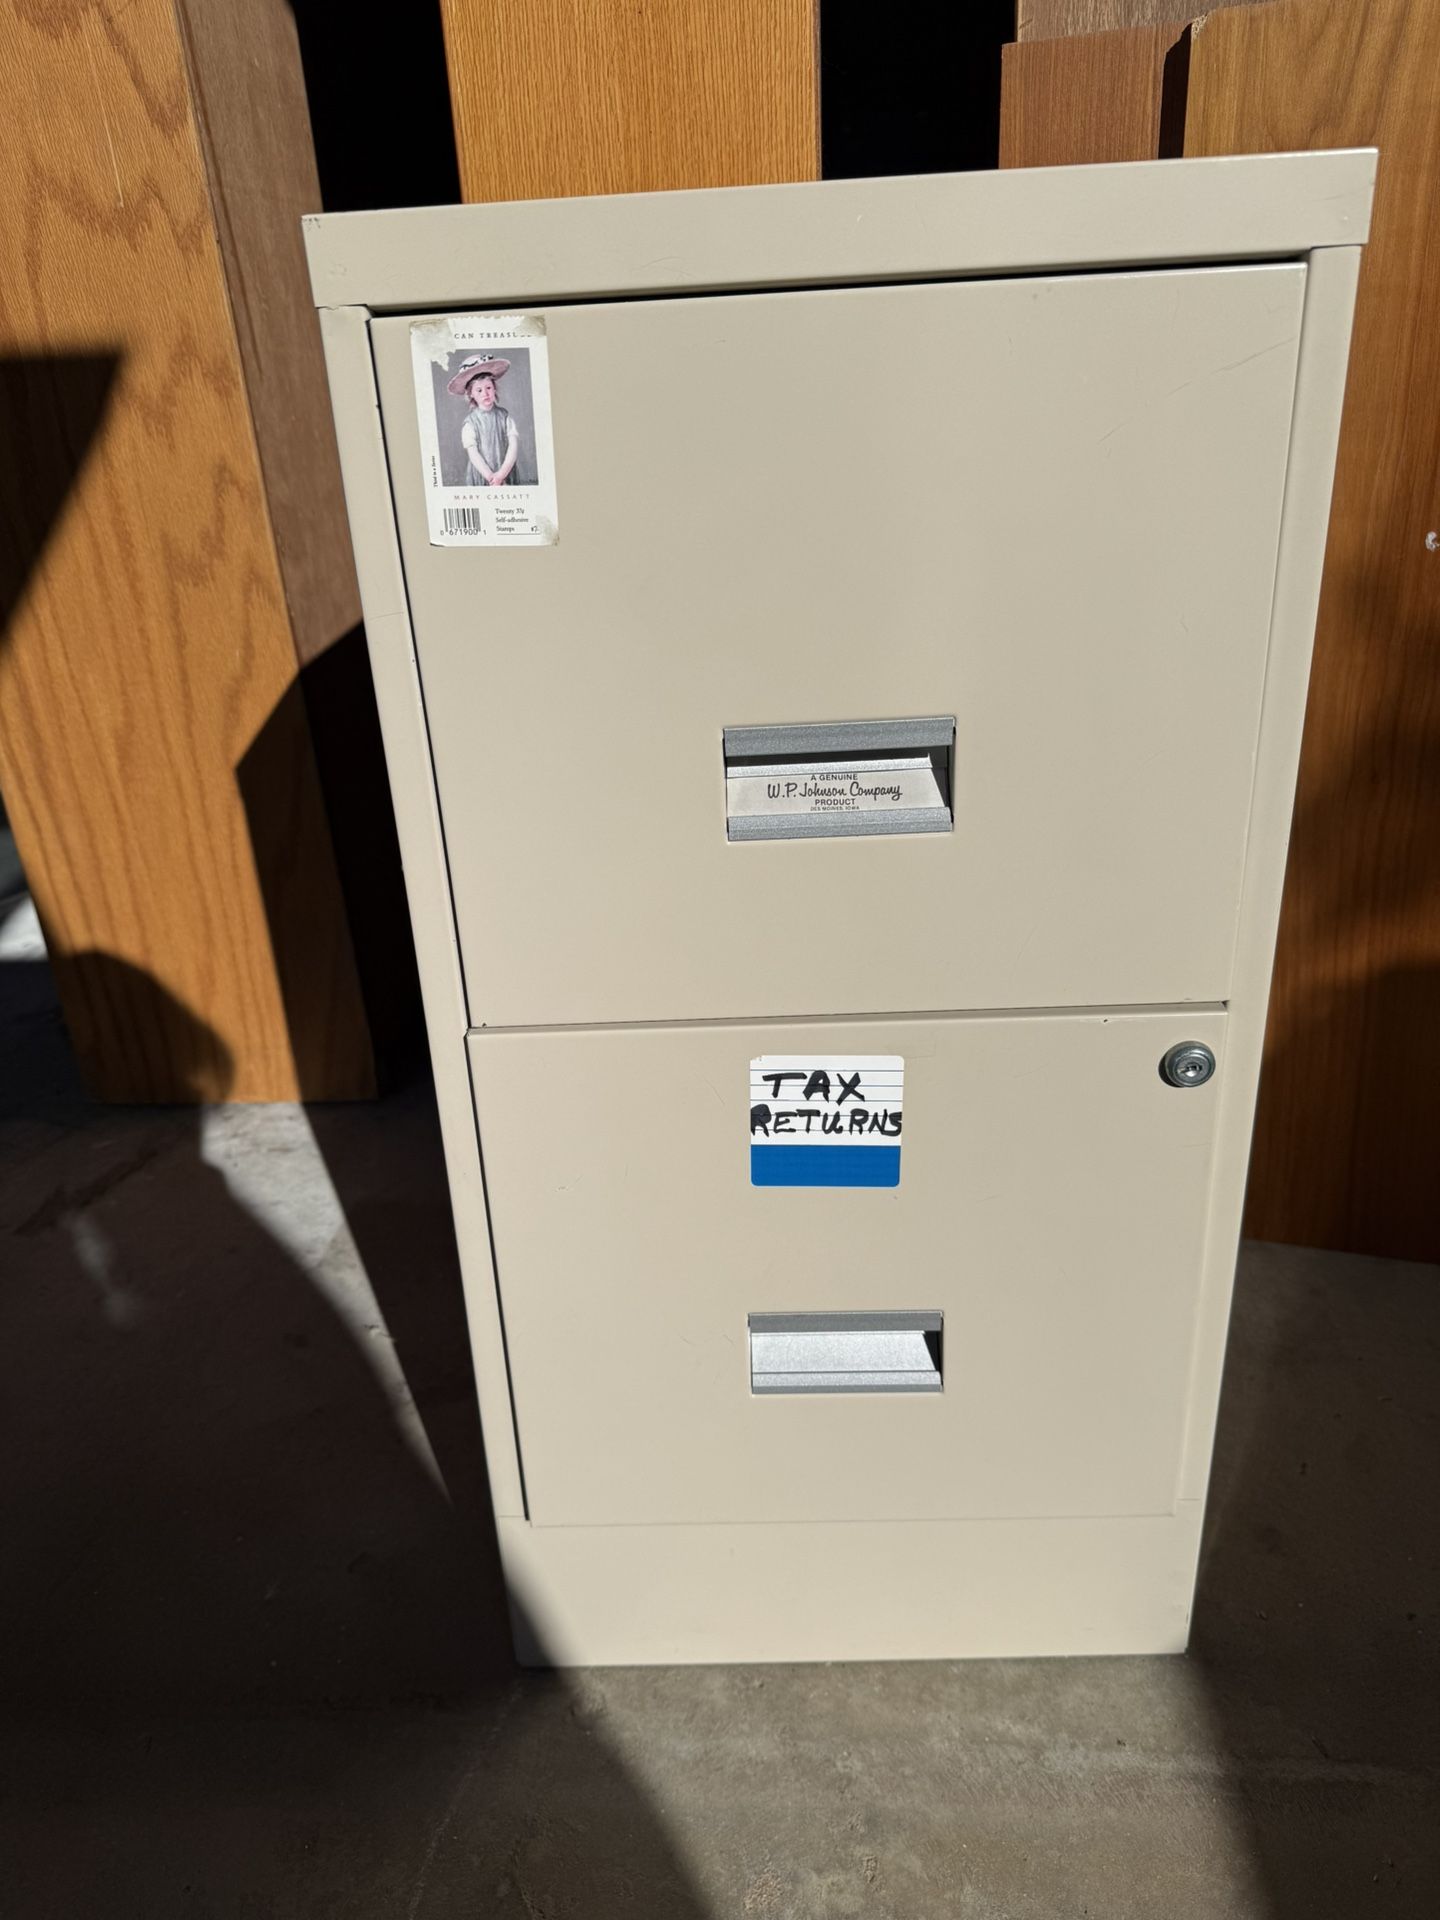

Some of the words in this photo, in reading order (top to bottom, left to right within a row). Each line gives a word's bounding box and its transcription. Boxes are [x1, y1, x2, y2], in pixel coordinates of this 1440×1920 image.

[798, 782, 847, 797] Johnson
[850, 781, 903, 801] Company
[815, 798, 856, 806] PRODUCT
[762, 1070, 865, 1106] TAX
[750, 1104, 902, 1138] RETURNS
